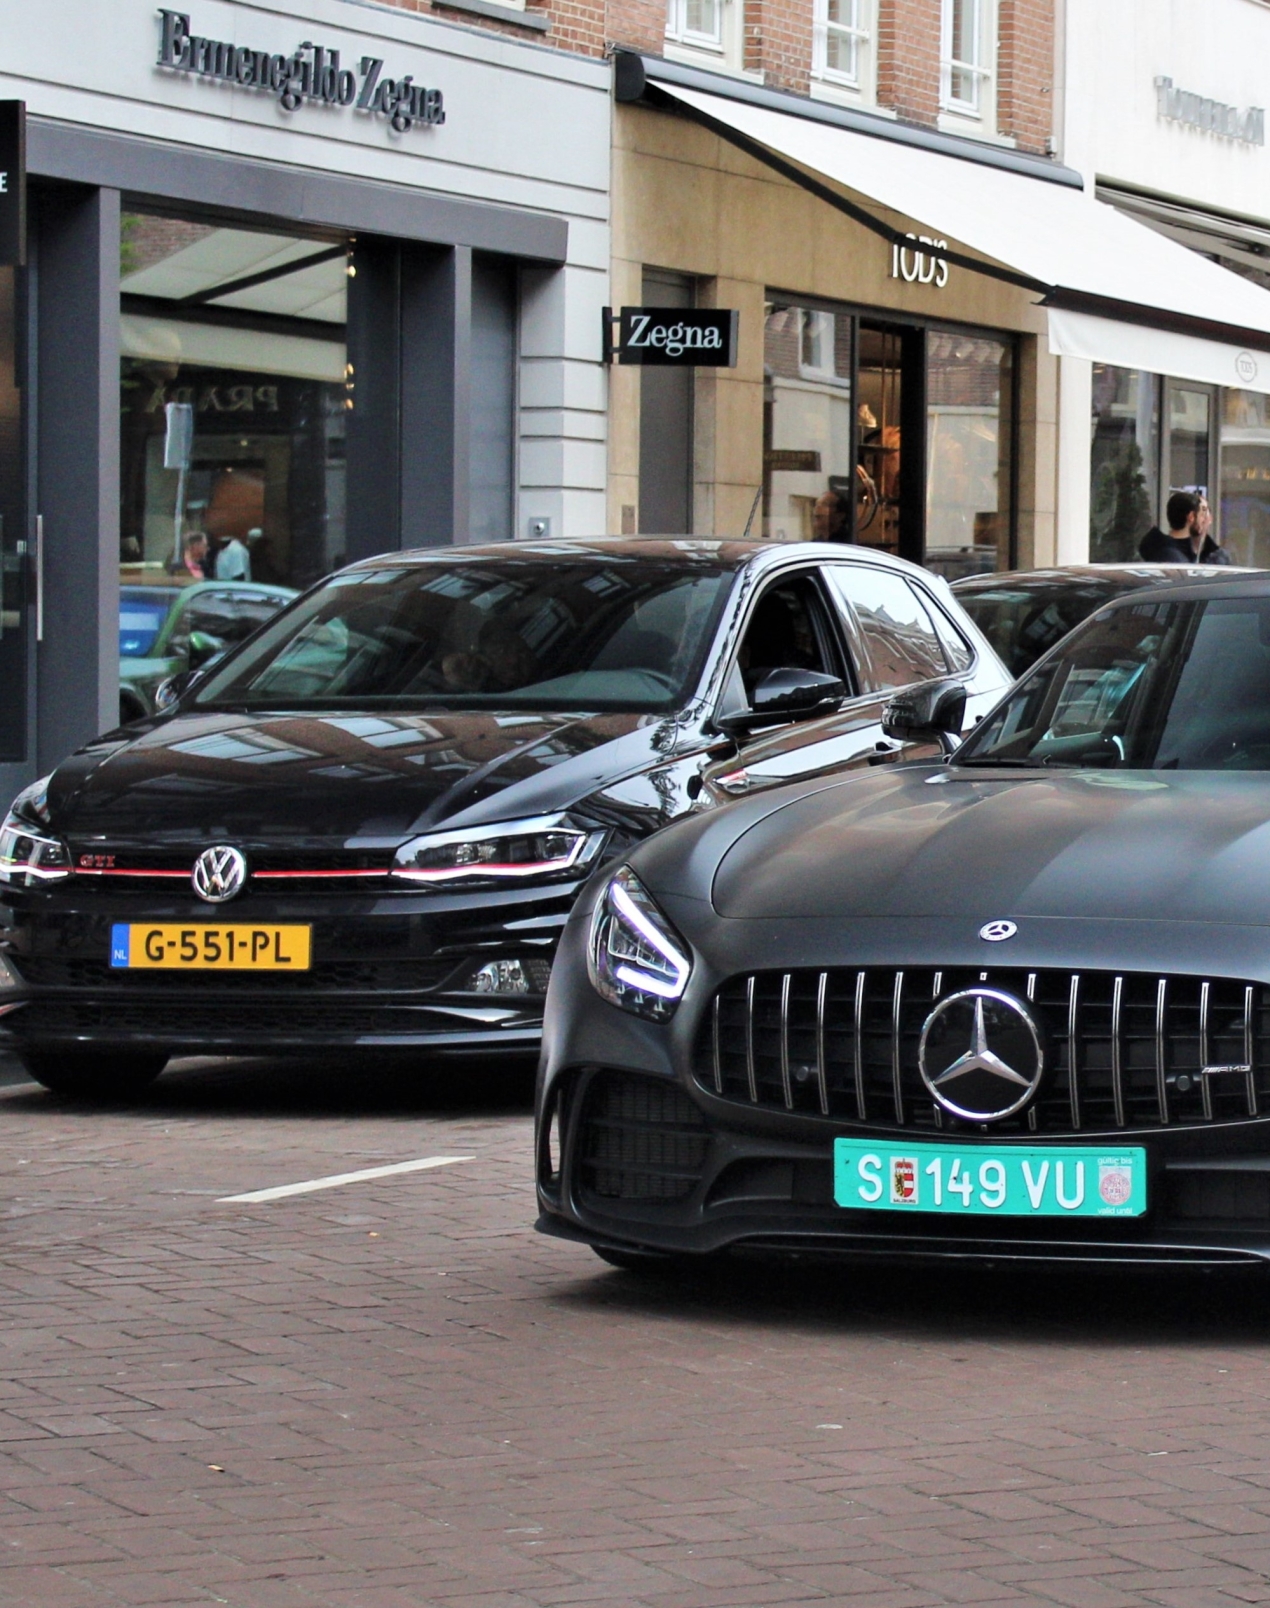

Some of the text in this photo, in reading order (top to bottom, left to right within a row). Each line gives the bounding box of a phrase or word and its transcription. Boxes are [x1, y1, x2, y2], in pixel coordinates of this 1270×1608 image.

[156, 9, 446, 132] Ermenegildo Zegna
[627, 315, 723, 357] Zegna
[80, 854, 116, 868] GTI
[114, 949, 127, 960] NL
[144, 929, 291, 963] G-551-PL
[857, 1153, 1085, 1210] S 149 VU
